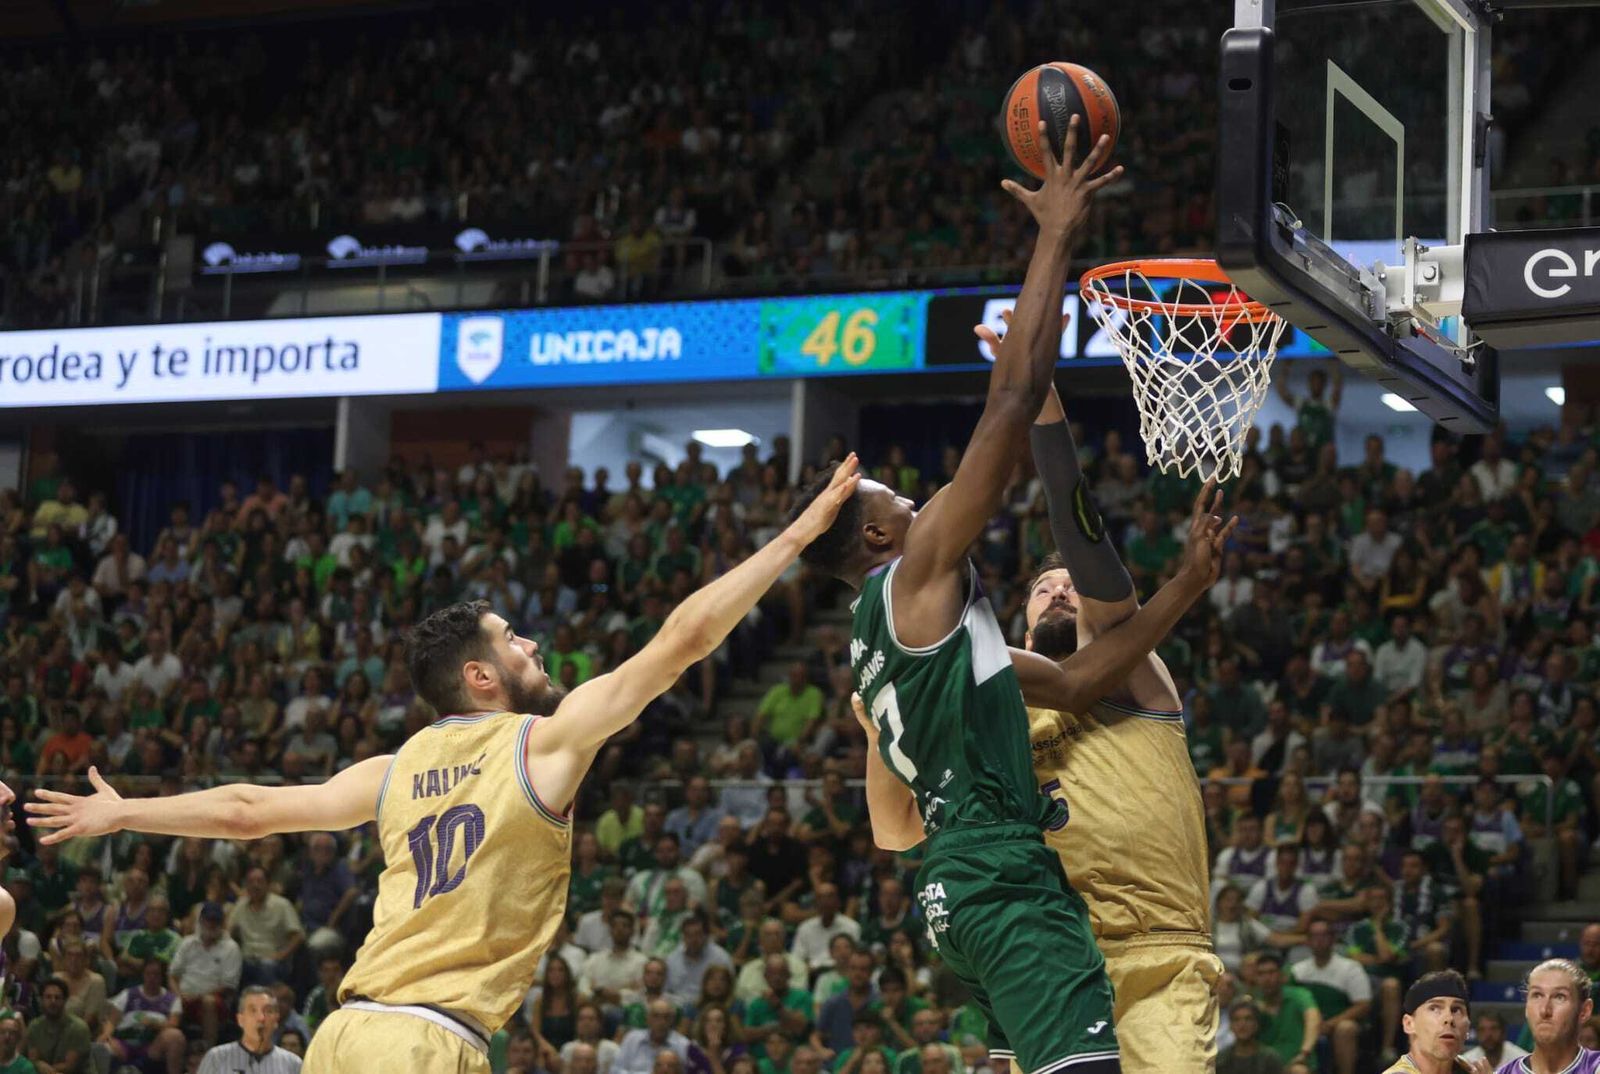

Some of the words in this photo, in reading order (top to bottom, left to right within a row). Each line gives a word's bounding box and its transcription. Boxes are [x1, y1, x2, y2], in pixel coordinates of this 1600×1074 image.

[116, 350, 138, 388] y
[152, 342, 189, 377] te
[202, 336, 360, 382] importa
[530, 327, 682, 365] UNICAJA
[802, 309, 878, 366] 46
[407, 803, 486, 910] 10
